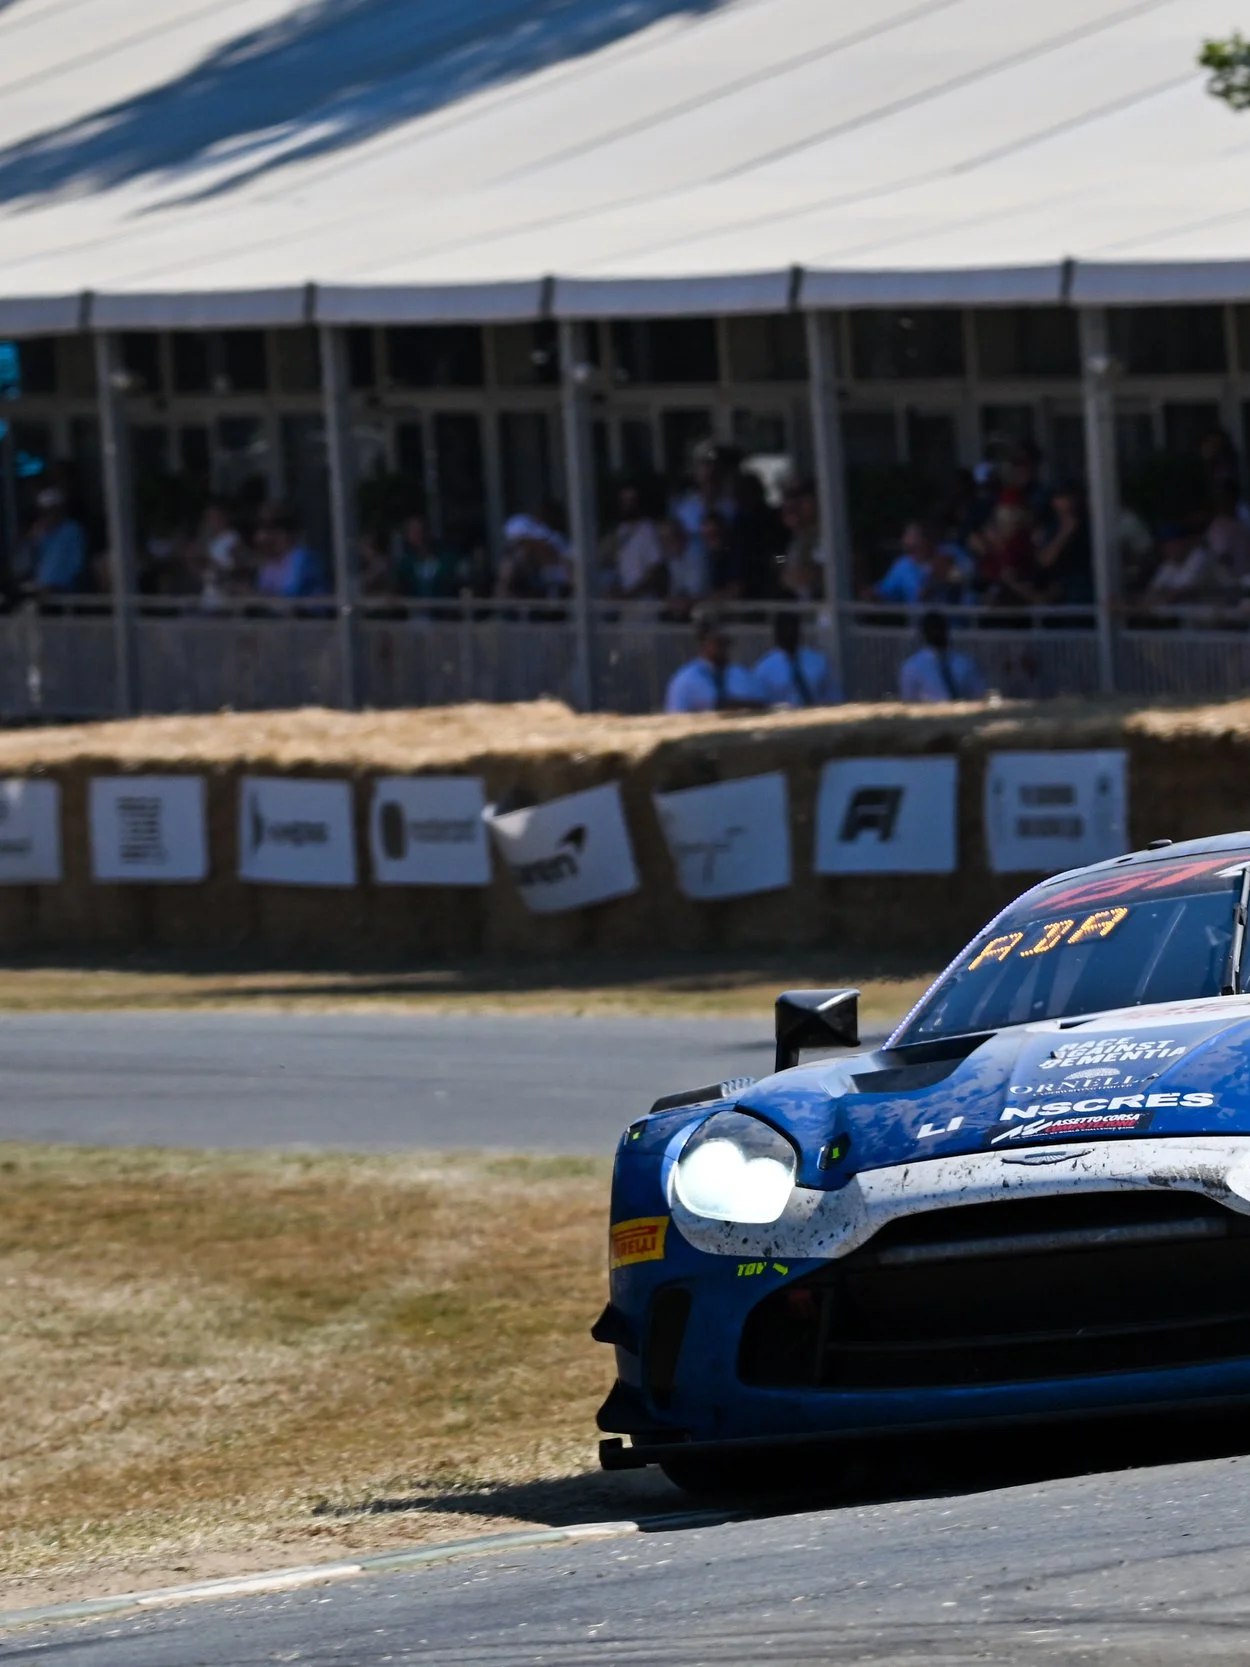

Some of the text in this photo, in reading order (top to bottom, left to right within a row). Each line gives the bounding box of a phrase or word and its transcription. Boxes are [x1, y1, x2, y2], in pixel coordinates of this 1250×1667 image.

[1039, 1046, 1187, 1069] DEMENTIA
[1052, 1113, 1142, 1127] ASSETTO CORSA
